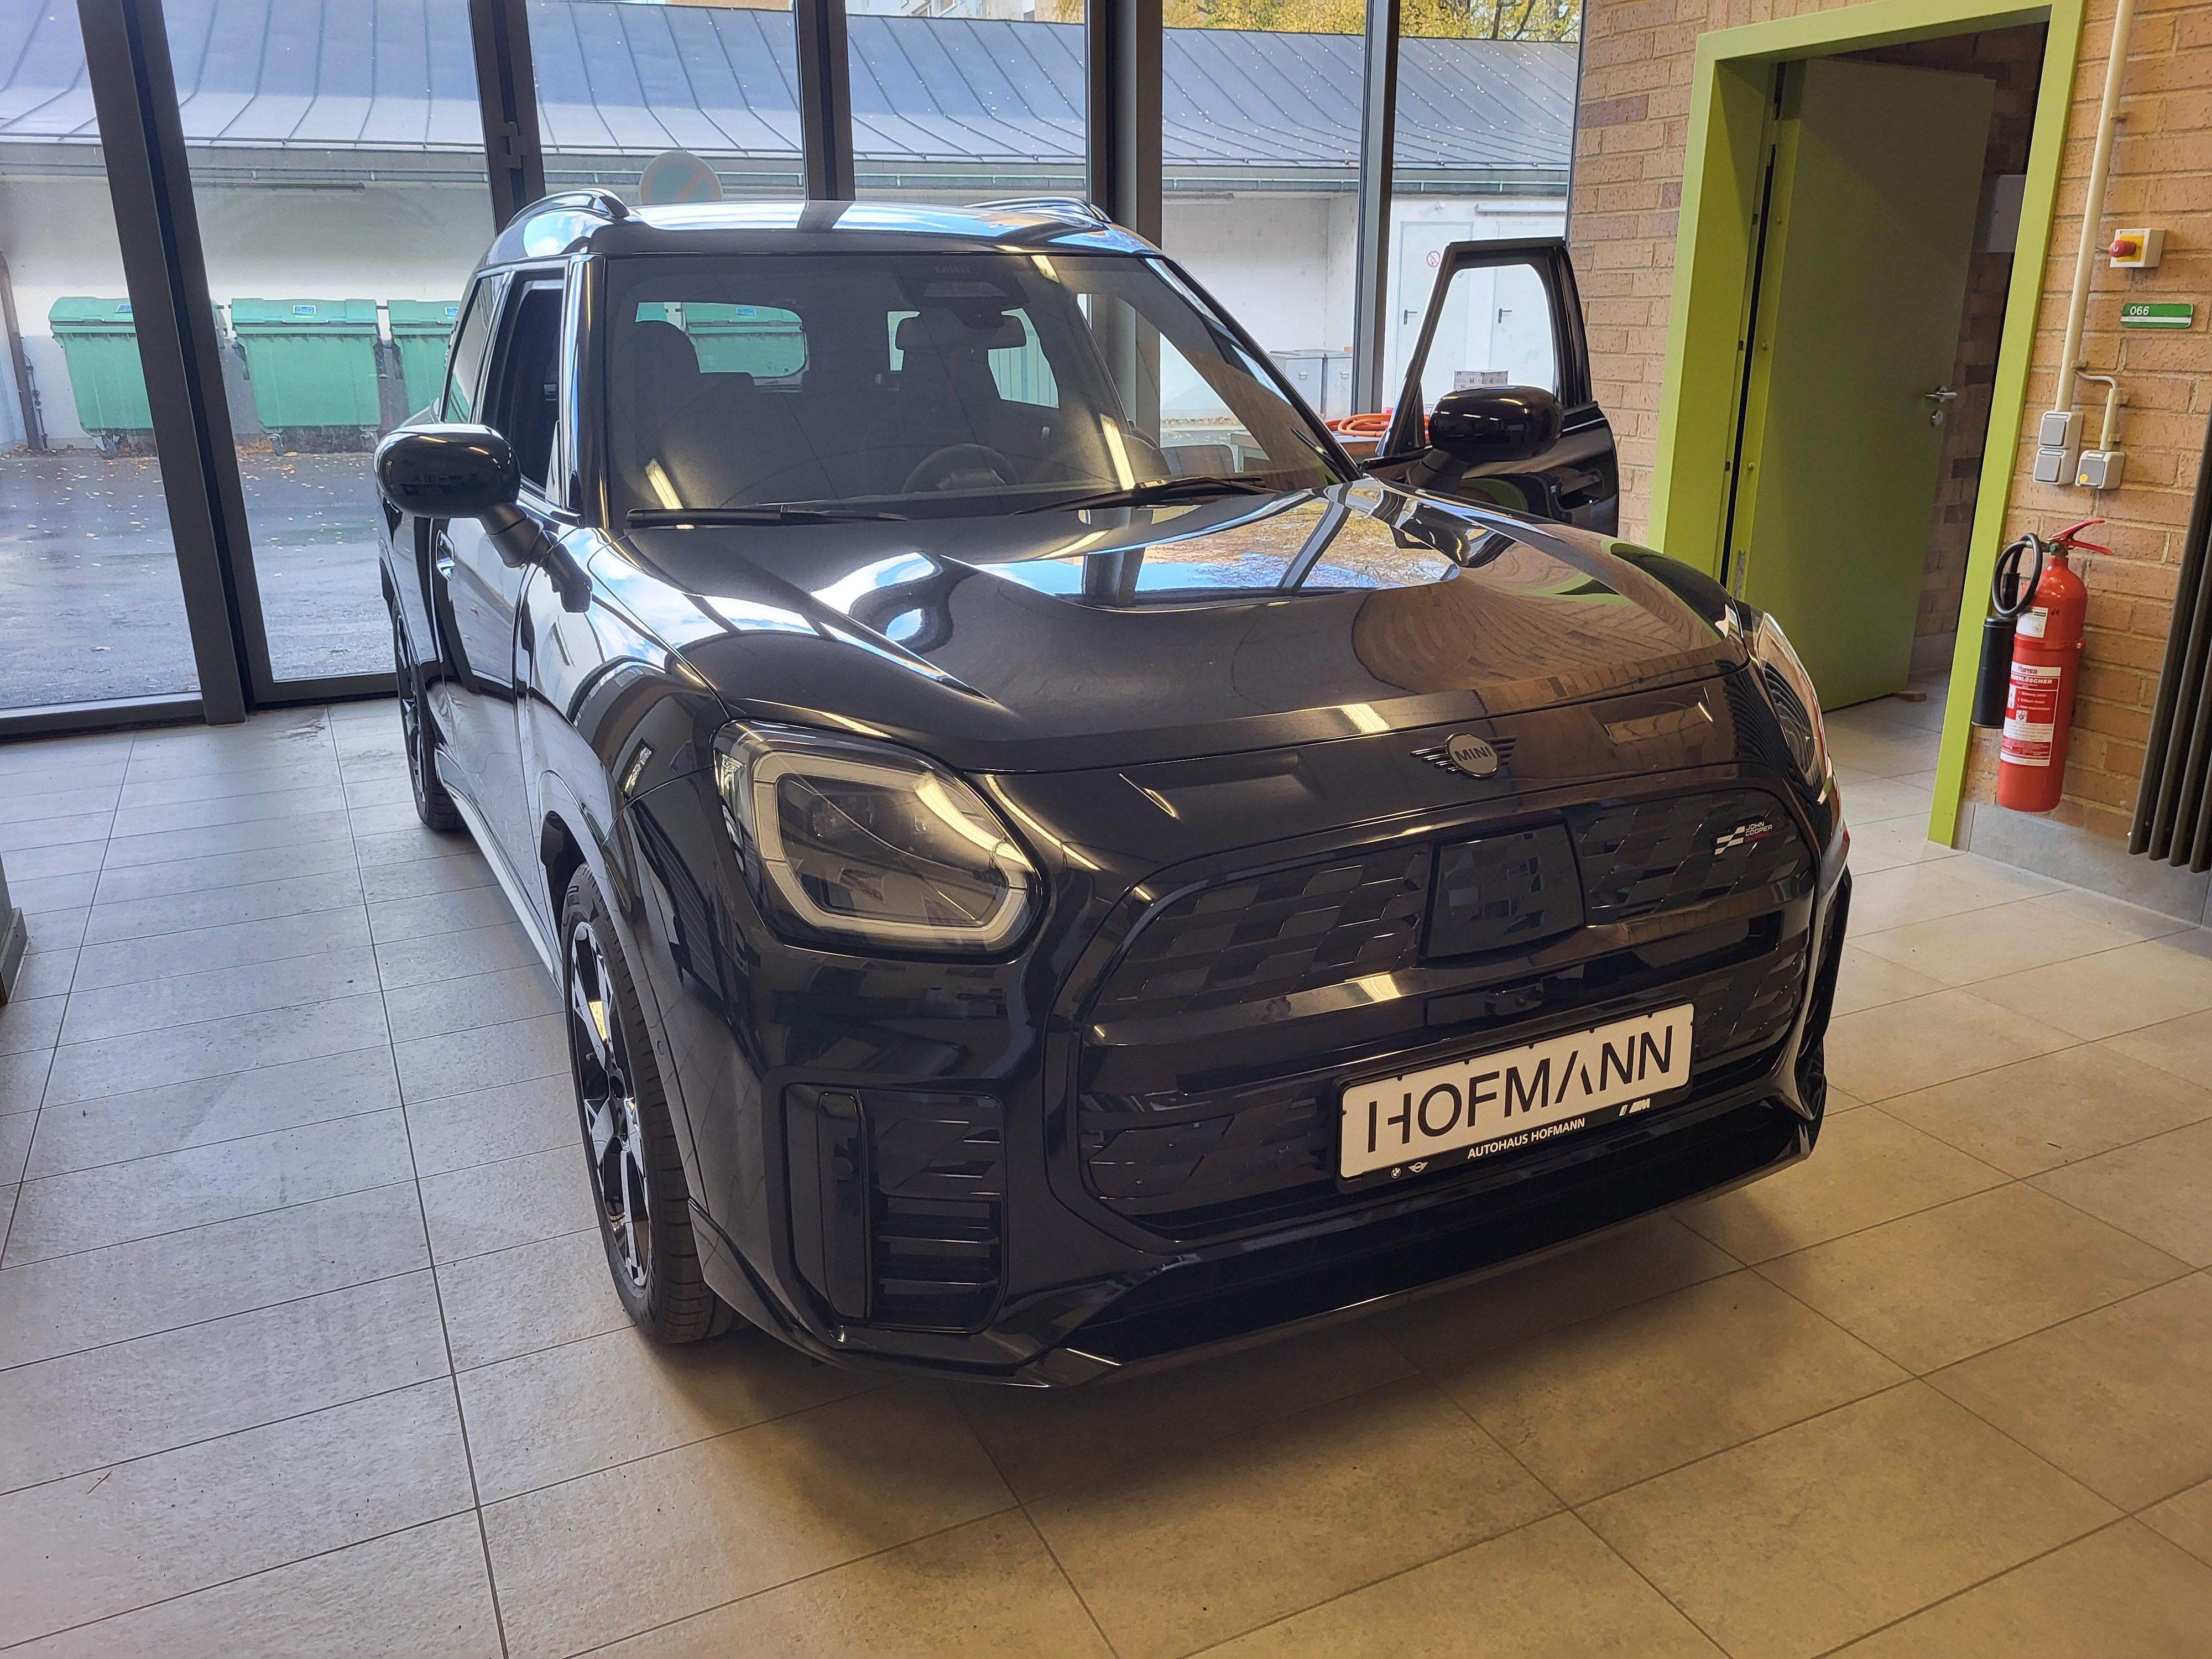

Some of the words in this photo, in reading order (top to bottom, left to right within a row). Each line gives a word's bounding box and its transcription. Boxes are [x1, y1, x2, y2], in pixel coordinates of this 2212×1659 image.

[2130, 306, 2150, 315] 066
[2017, 665, 2037, 674] Hansa
[1454, 746, 1493, 761] MINI
[1745, 821, 1765, 831] JOHN
[1745, 824, 1772, 837] COOPER
[1368, 1025, 1673, 1153] HOFMANN
[1467, 1134, 1528, 1159] AUTOHAUS
[1531, 1117, 1585, 1142] HOFMANN
